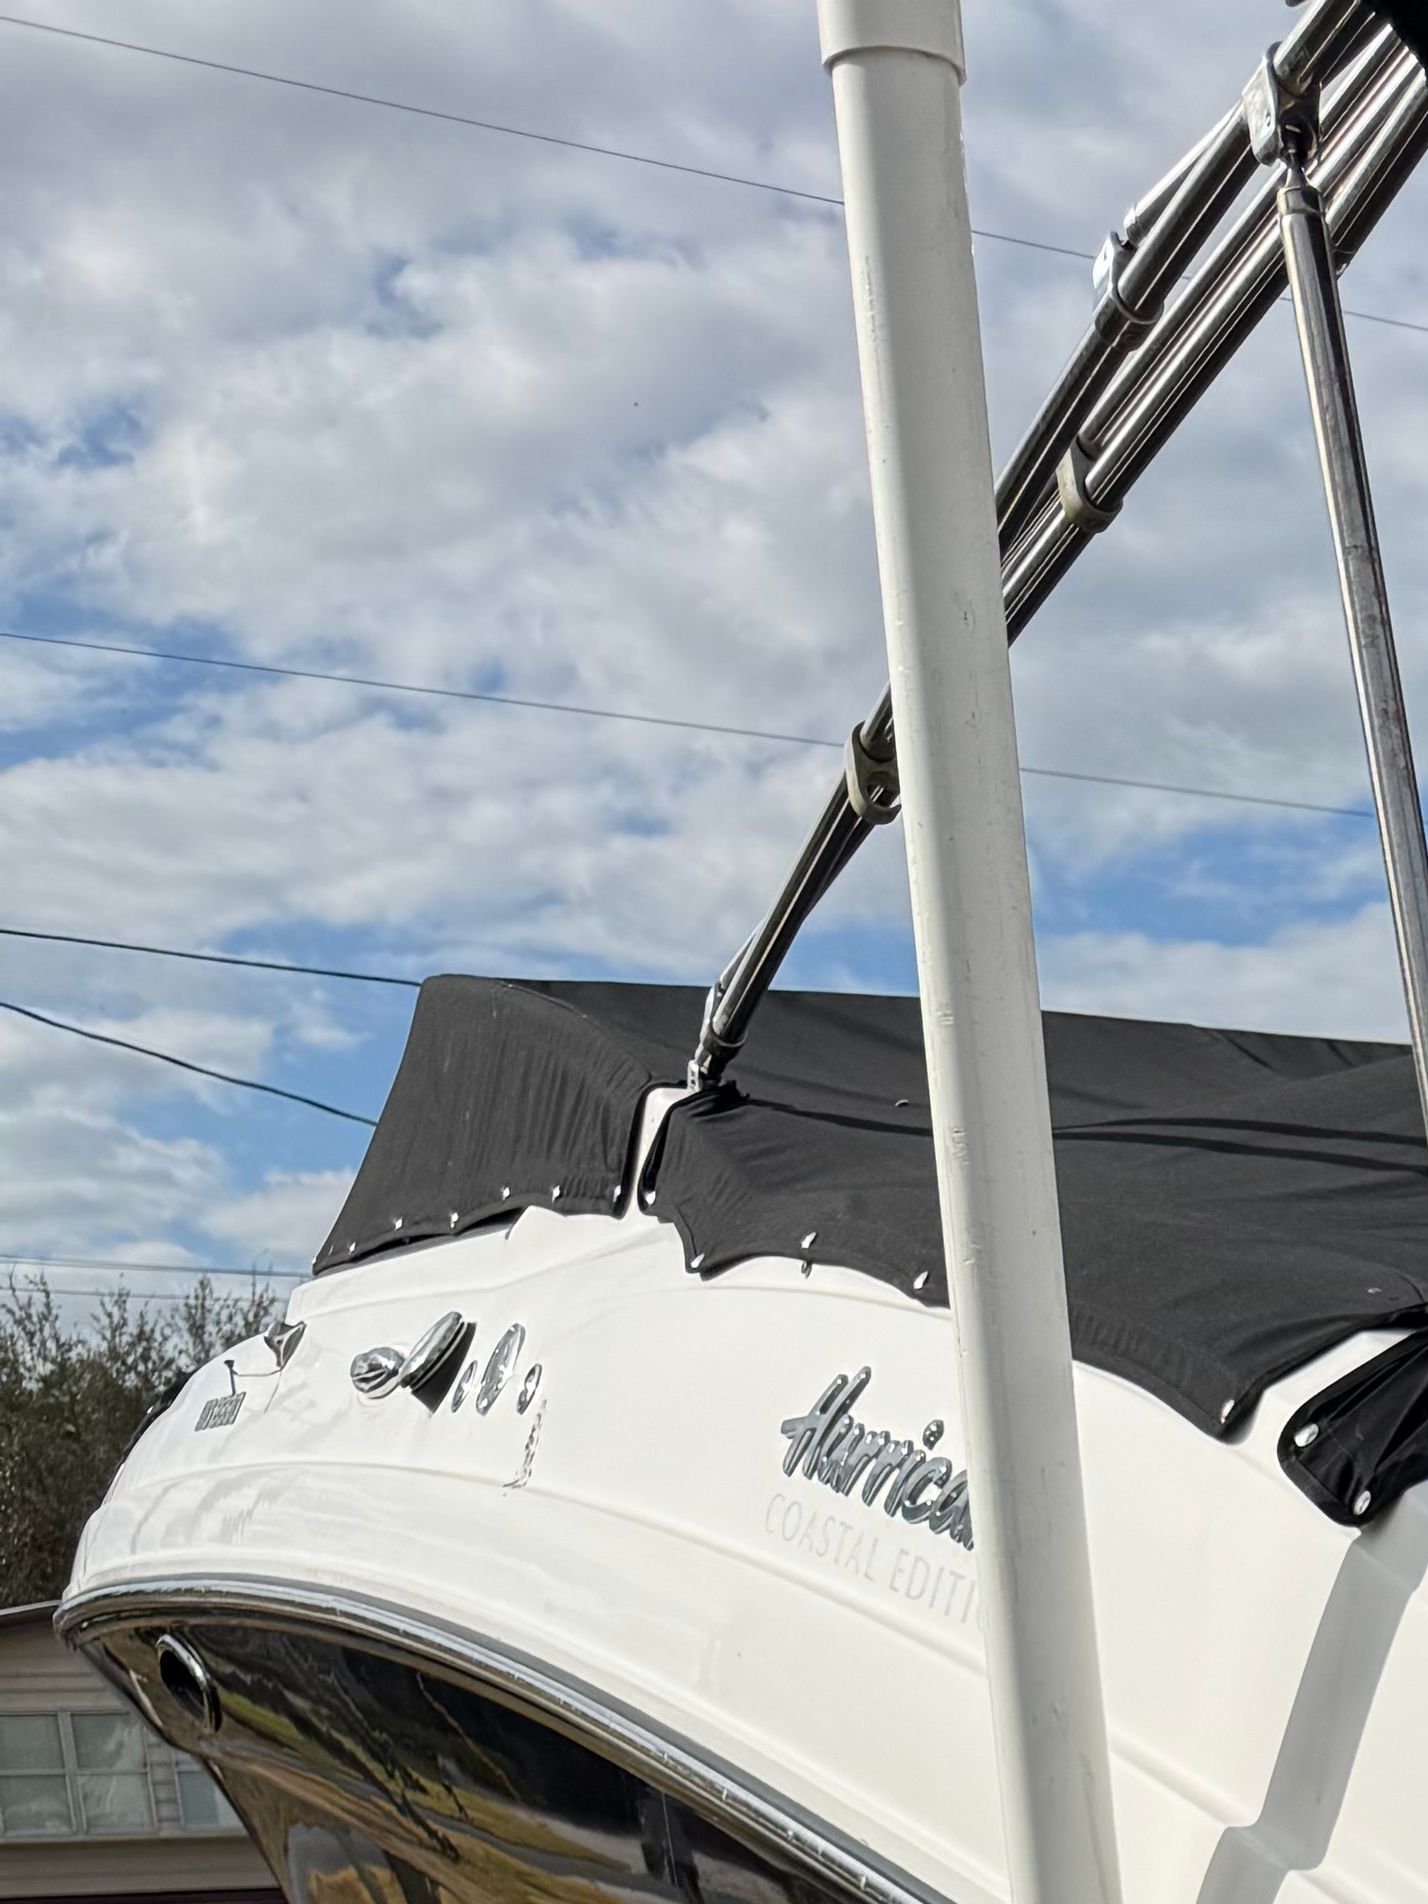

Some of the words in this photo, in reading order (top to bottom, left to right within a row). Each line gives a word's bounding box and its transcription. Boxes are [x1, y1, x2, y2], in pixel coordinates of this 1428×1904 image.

[780, 1365, 974, 1551] Hurrica
[764, 1492, 880, 1582] COASTAL
[888, 1547, 981, 1630] EDITI
